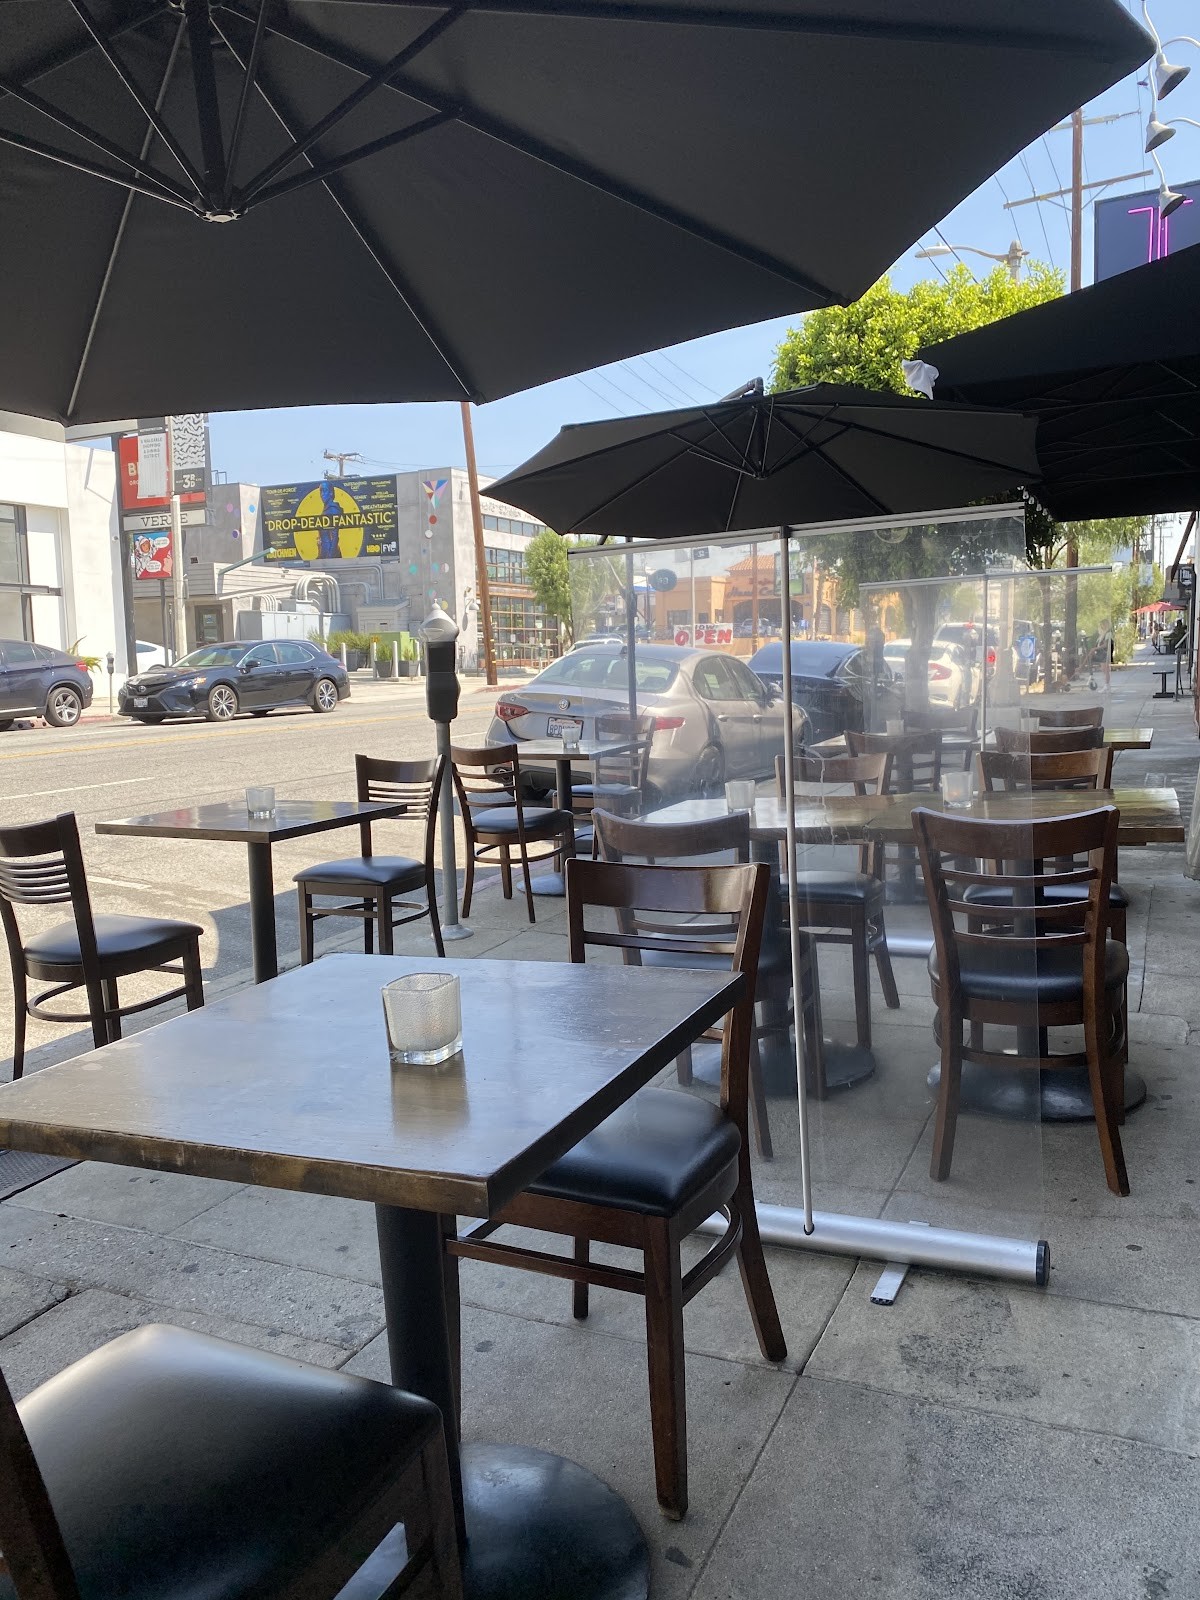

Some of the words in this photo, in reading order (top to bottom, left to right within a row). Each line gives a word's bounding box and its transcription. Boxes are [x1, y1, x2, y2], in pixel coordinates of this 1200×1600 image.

[141, 513, 188, 527] VERE
[333, 511, 396, 527] FANTASTIC"
[675, 629, 732, 646] OPEN
